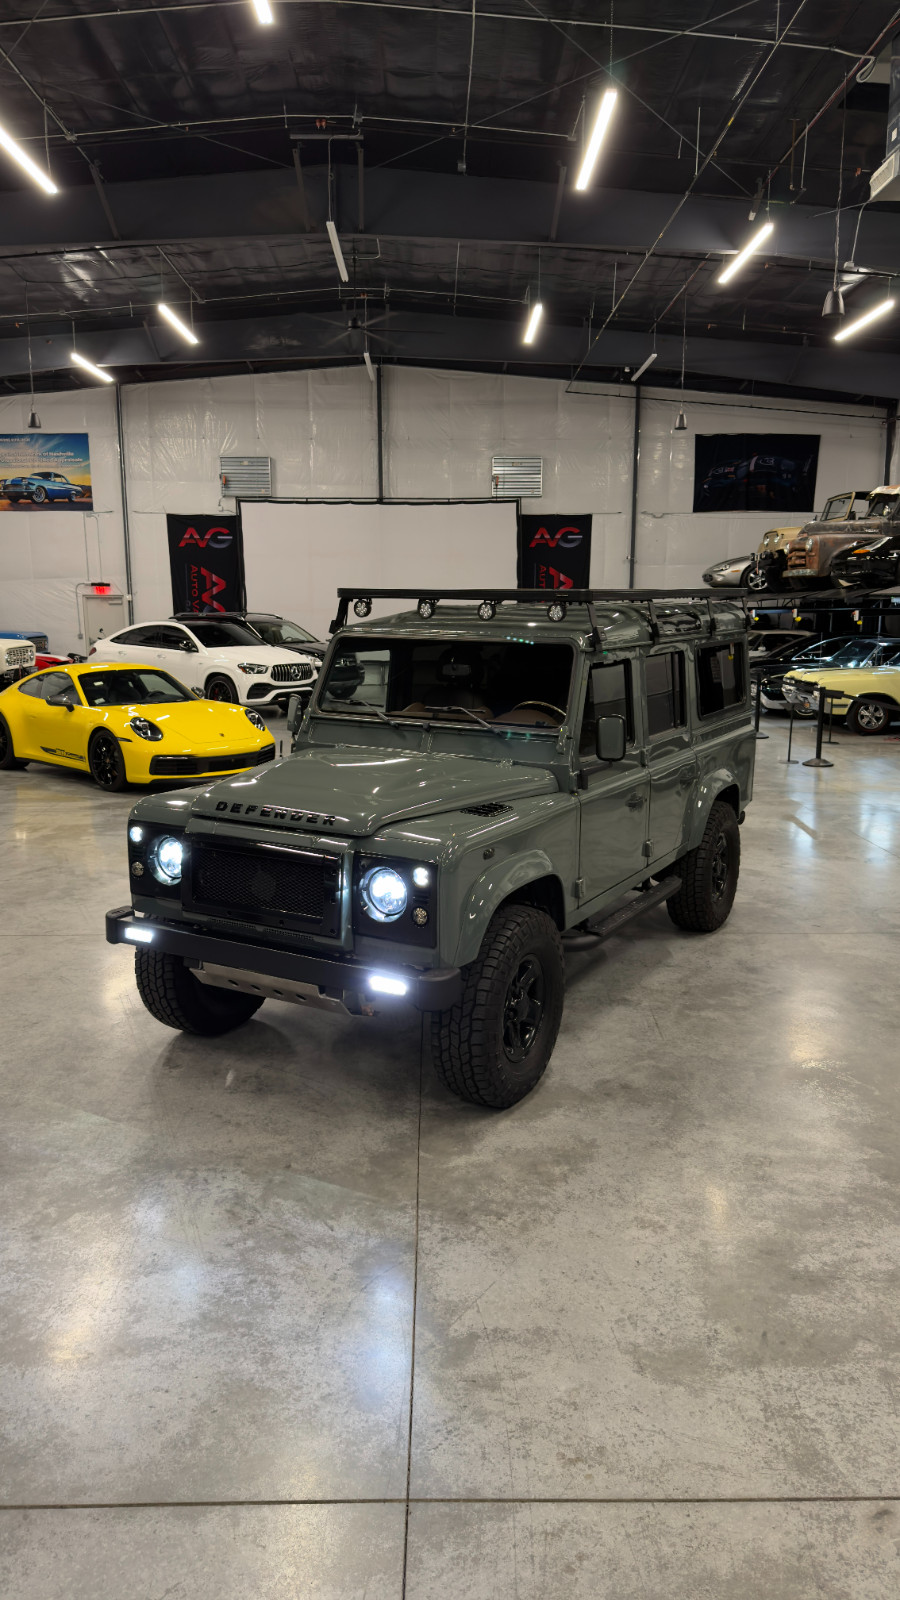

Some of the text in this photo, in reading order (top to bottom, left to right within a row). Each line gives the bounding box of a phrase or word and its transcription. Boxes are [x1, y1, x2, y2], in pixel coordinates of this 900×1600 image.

[178, 527, 233, 549] AVG
[529, 526, 583, 548] AVG
[190, 564, 199, 597] AUTO
[539, 564, 547, 589] AUT
[215, 801, 336, 826] DEFENDER
